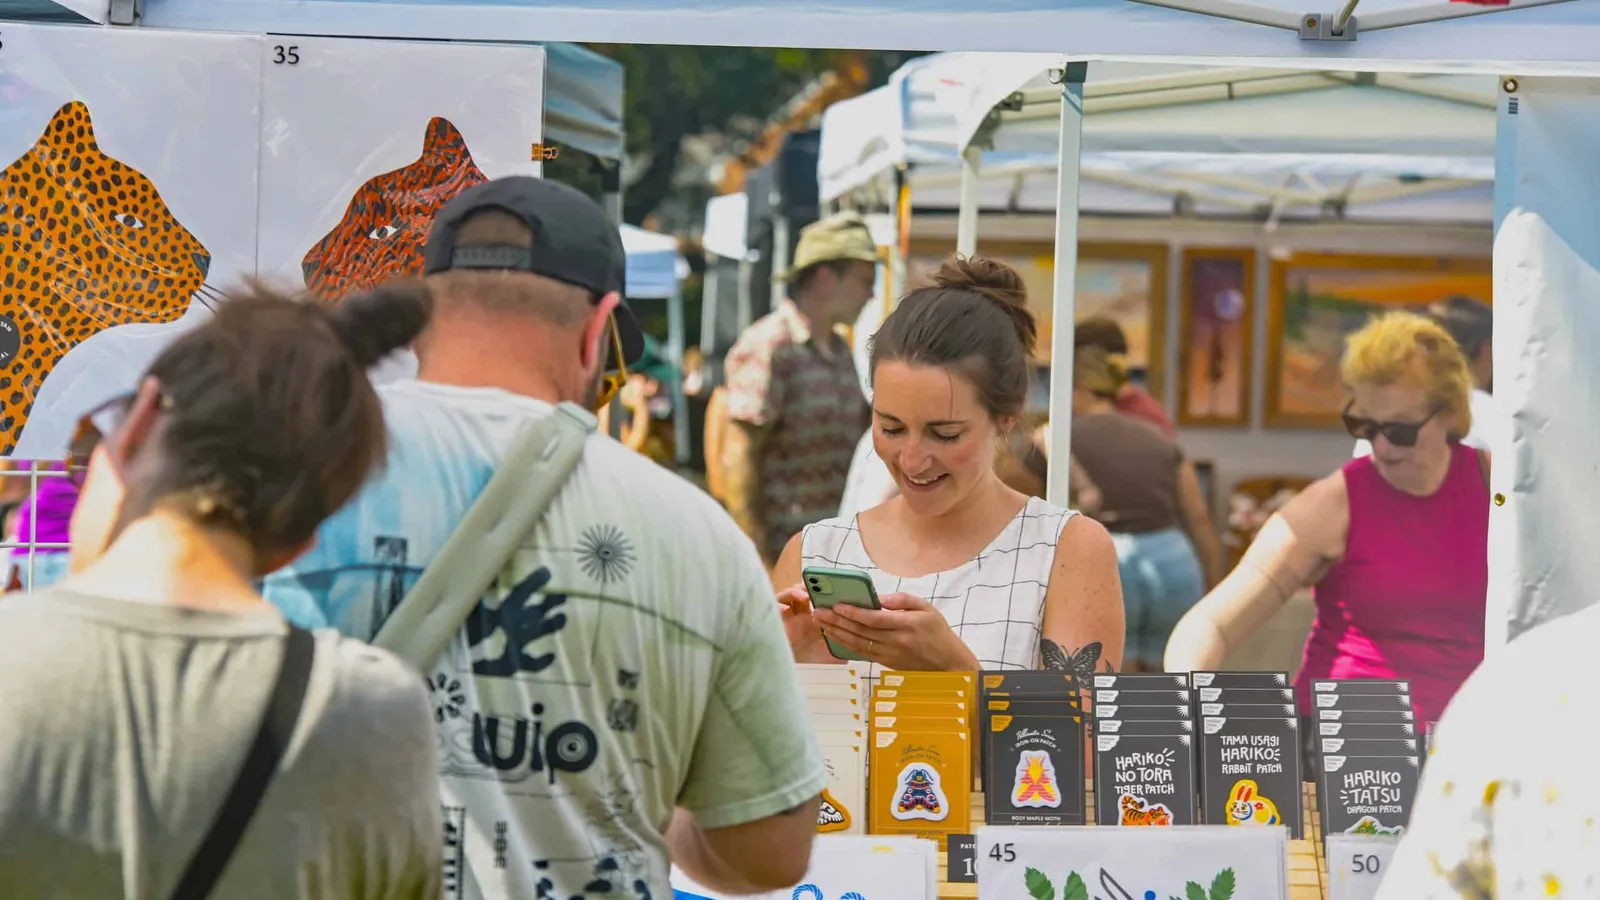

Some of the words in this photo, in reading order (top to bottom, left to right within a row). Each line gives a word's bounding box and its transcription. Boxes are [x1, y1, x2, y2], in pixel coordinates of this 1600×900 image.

[273, 45, 299, 64] 35
[0, 321, 12, 332] TAN
[1040, 738, 1057, 748] PATCH
[1220, 735, 1248, 746] TAMA
[1115, 752, 1164, 771] HARIKO
[1220, 747, 1275, 763] HARIKO
[1115, 771, 1136, 783] NO
[1136, 767, 1173, 784] TORA
[1256, 763, 1282, 774] PATCH
[1343, 770, 1401, 788] HARIKO
[1144, 783, 1175, 795] PATCH
[1349, 786, 1401, 805] TATSU
[1347, 805, 1378, 814] DRAGON
[1379, 805, 1402, 813] PATCH
[989, 843, 1016, 862] 45
[1352, 854, 1380, 873] 50
